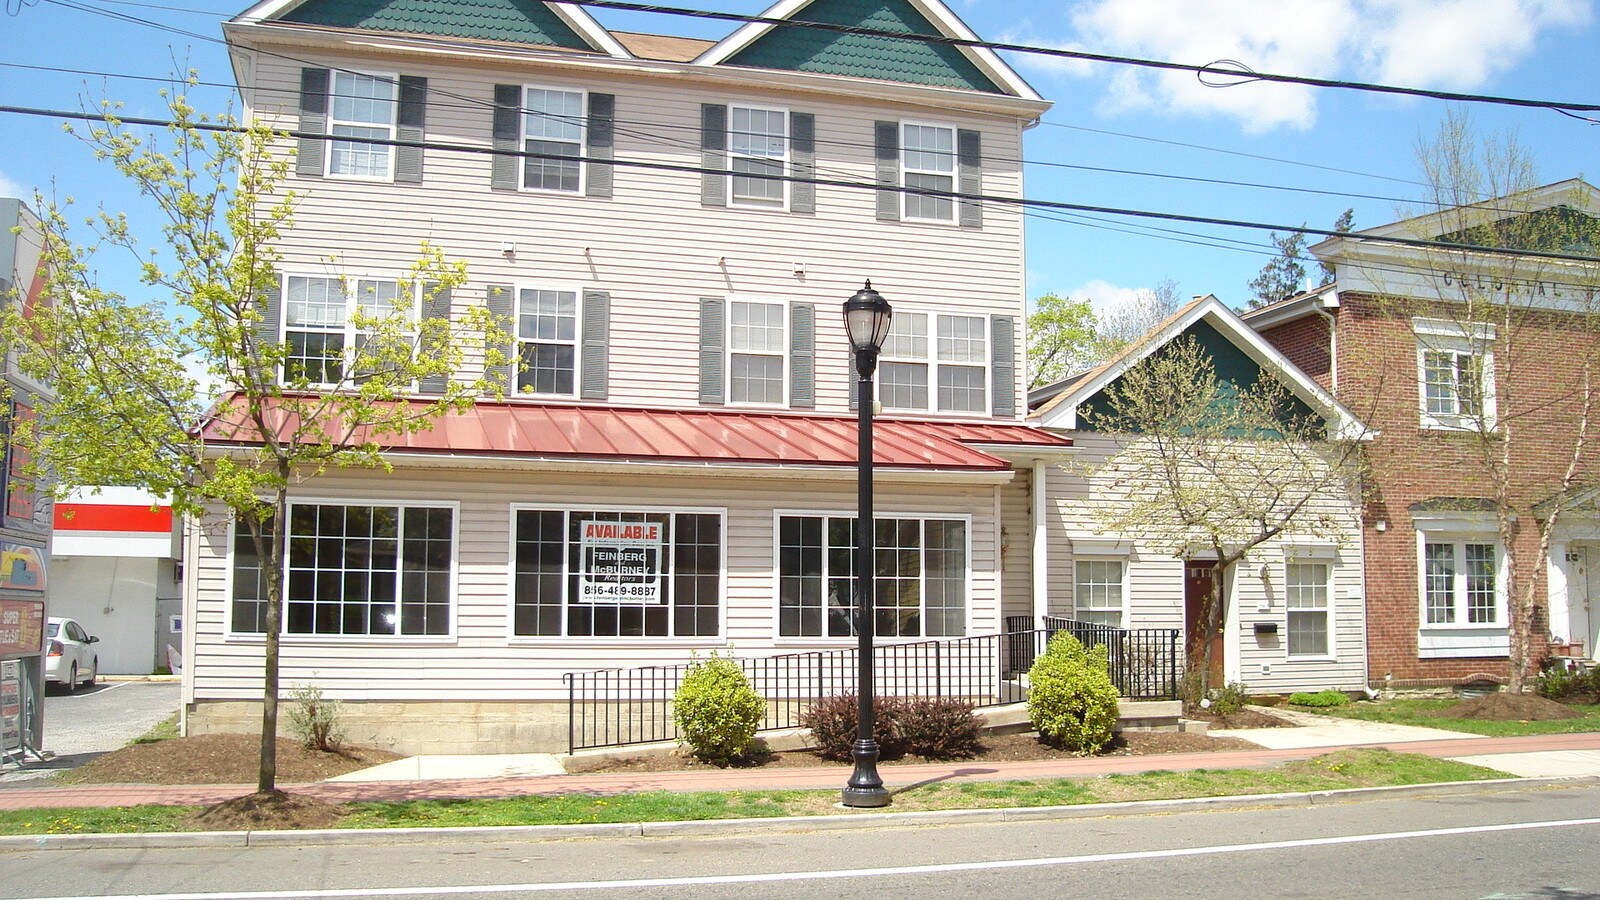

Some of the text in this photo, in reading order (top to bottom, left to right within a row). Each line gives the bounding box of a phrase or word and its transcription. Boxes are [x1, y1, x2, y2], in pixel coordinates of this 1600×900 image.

[586, 524, 657, 539] AVAILABLE
[593, 552, 647, 561] FEINBERG
[591, 565, 650, 574] McBURNEY
[584, 585, 656, 596] 856-489-8887
